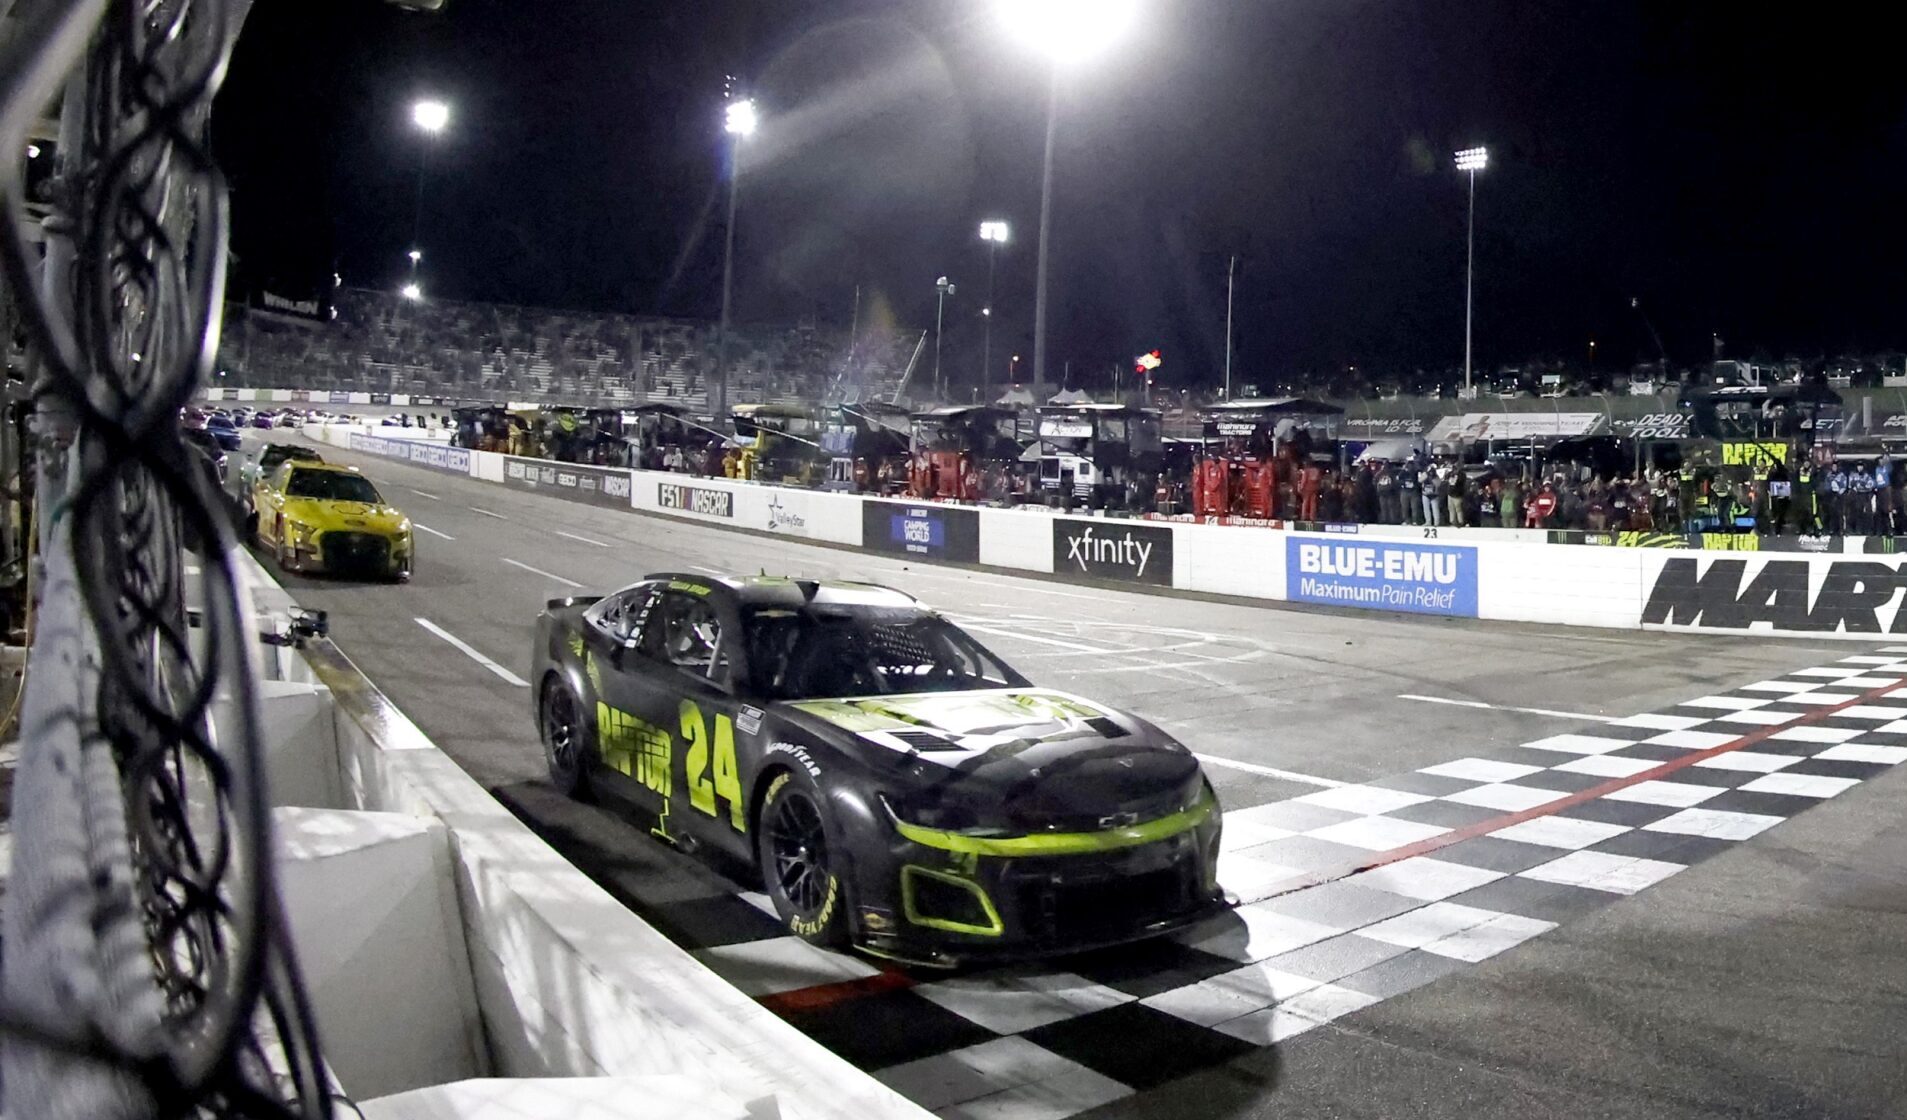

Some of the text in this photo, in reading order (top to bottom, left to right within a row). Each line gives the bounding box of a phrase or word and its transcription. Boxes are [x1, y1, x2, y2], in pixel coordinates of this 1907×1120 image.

[1638, 413, 1684, 426] DEAD
[1628, 427, 1688, 439] TOOL
[1721, 442, 1789, 466] RAPTOR
[604, 475, 630, 497] NASCAR
[660, 484, 729, 516] FS1 NASCAR
[903, 519, 930, 532] CAMPING
[904, 528, 931, 543] WORLD
[1423, 528, 1438, 540] 23
[1616, 531, 1639, 547] 24
[1067, 526, 1153, 577] xfinity
[1299, 544, 1457, 584] BLUE-EMU
[1300, 577, 1456, 609] Maximum Pain Relief
[678, 698, 746, 834] 24
